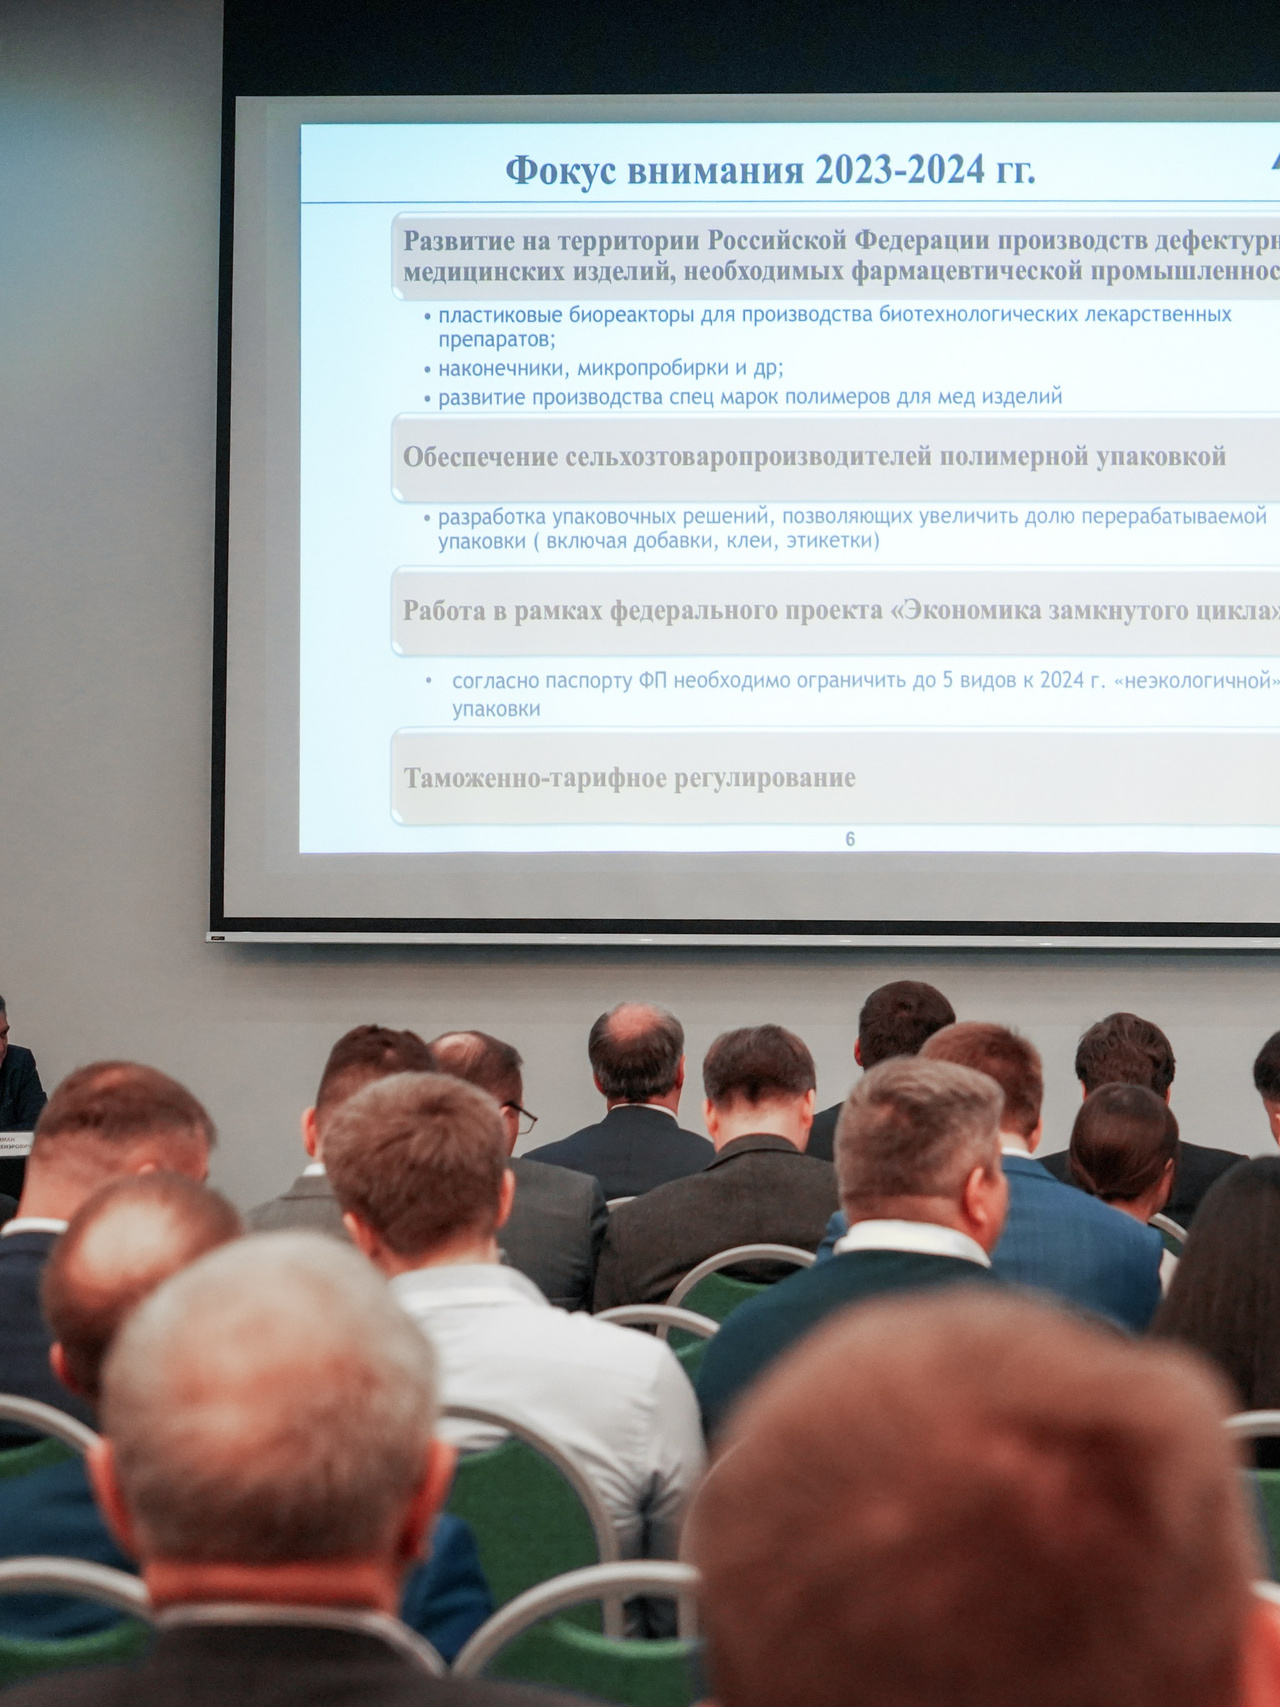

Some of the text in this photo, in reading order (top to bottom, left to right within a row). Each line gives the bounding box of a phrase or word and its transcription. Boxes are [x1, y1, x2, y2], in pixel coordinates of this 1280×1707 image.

[506, 152, 1035, 193] Фокус внимания 2023-2024 гг.
[404, 230, 515, 251] Развитие
[522, 235, 551, 250] на
[558, 235, 699, 257] территории
[708, 229, 846, 250] Российской
[855, 229, 989, 256] Федерации
[998, 234, 1148, 256] производств
[404, 266, 565, 285] медицинских
[573, 260, 676, 285] изделий,
[684, 259, 844, 283] необходимых
[852, 259, 1082, 286] фармацевтической
[439, 303, 1232, 327] пластиковые биореакторы для производства биотехнологических лекарственных
[439, 333, 555, 351] препаратов;
[439, 357, 784, 380] наконечники, микропробирки и др;
[439, 385, 1063, 410] развитие производства спец марок полимеров для мед изделий
[403, 444, 1226, 472] Обеспечение сельхозтоваропроизводителей полимерной упаковкой
[439, 505, 1267, 529] разработка упаковочных решений, позволяющих увеличить долю перерабатываемой
[438, 535, 525, 553] упаковки
[547, 534, 627, 550] включая
[633, 530, 718, 552] добавки,
[727, 534, 778, 552] клеи,
[787, 531, 880, 552] этикетки)
[403, 599, 486, 621] Работа
[493, 605, 507, 620] в
[514, 605, 603, 627] рамках
[610, 598, 778, 627] федерального
[786, 604, 883, 626] проекта
[891, 598, 1042, 620] «Экономика
[1049, 604, 1188, 626] замкнутого
[452, 674, 539, 690] согласно
[546, 674, 633, 693] паспорту
[639, 671, 667, 690] ФП
[673, 670, 790, 693] необходимо
[797, 674, 906, 693] ограничить
[913, 675, 936, 692] до
[943, 670, 953, 688] 5
[961, 675, 1016, 689] видов
[1024, 674, 1034, 688] к
[1040, 670, 1084, 688] 2024
[1091, 675, 1106, 688] г.
[452, 702, 541, 720] упаковки
[404, 766, 856, 794] Таможенно-тарифное регулирование
[845, 831, 856, 847] 6
